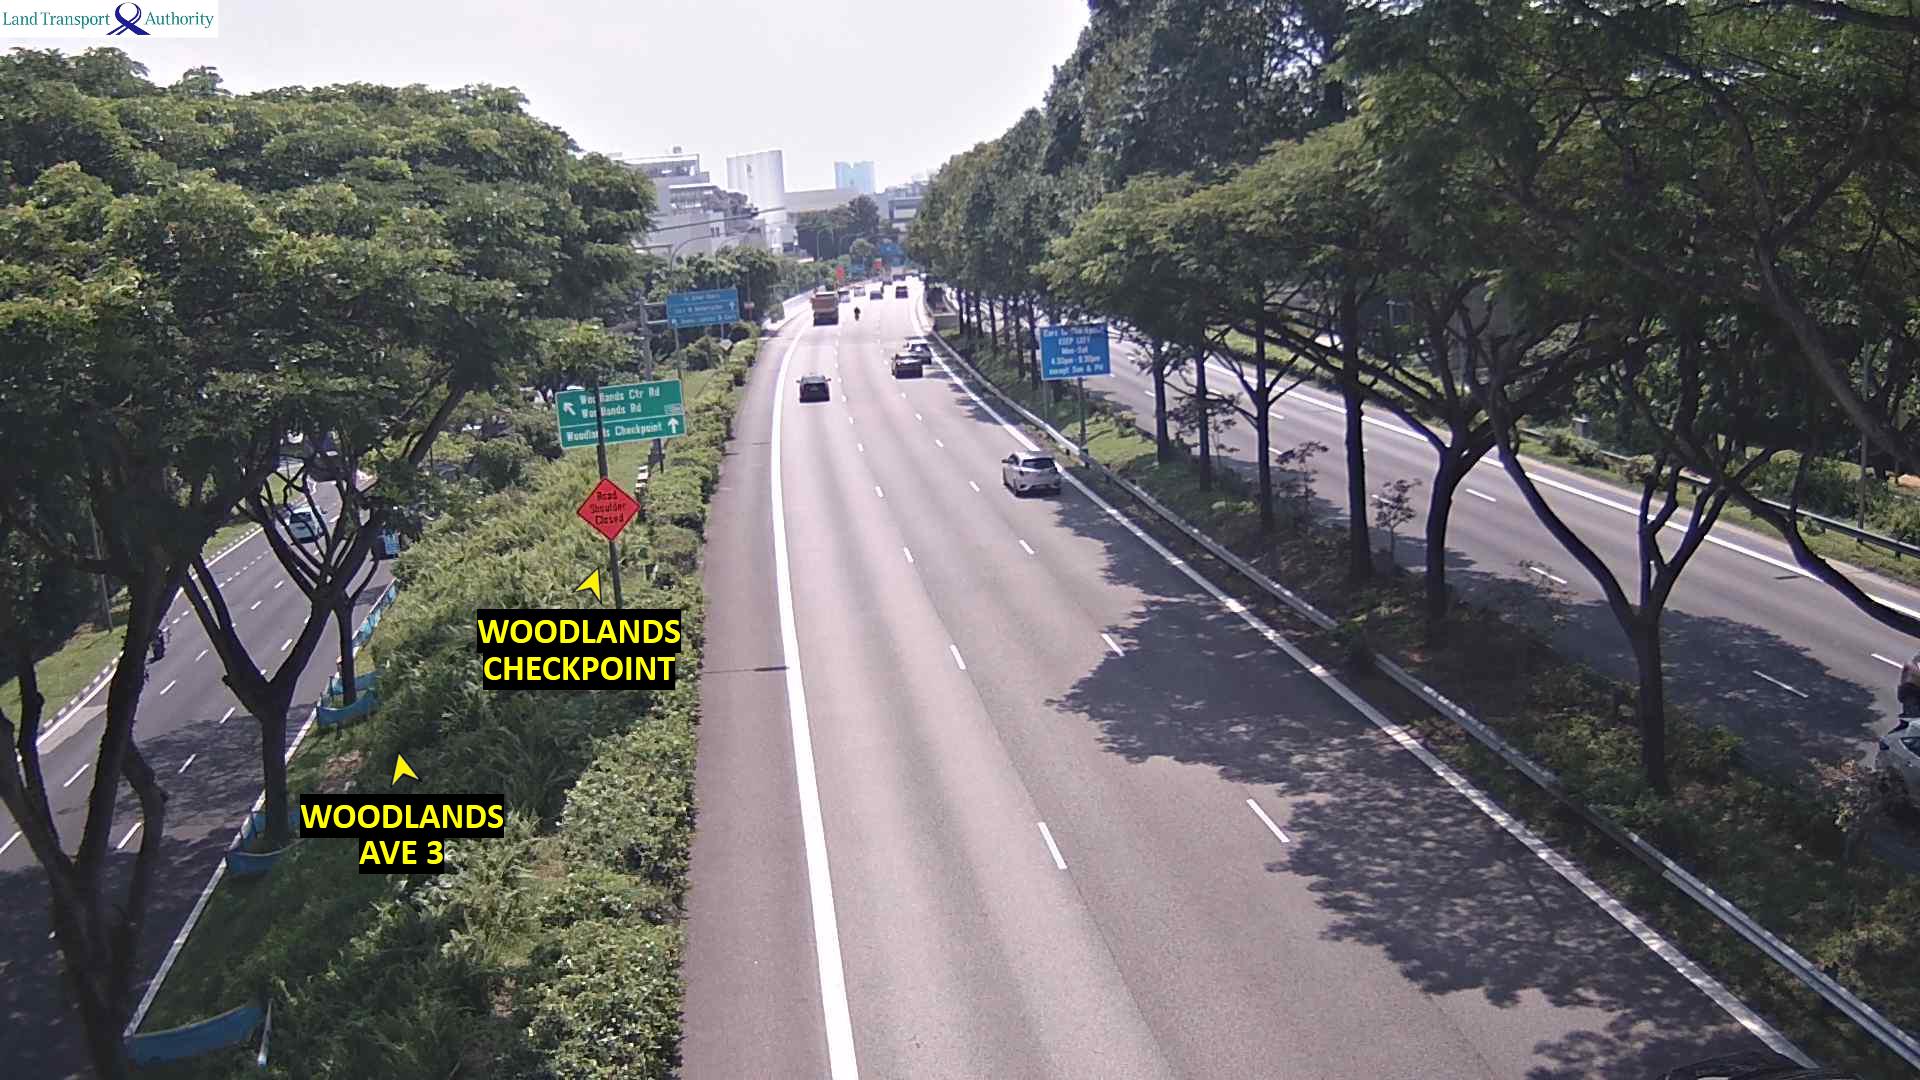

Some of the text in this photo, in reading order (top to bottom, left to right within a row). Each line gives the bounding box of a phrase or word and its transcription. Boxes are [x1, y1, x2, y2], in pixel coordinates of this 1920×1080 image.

[629, 388, 643, 400] Ctr
[649, 386, 660, 398] Rd
[630, 402, 641, 413] Rd
[615, 422, 662, 436] Checkpoint
[597, 490, 617, 500] Road
[590, 503, 626, 513] Shoulder
[595, 512, 623, 525] Closed
